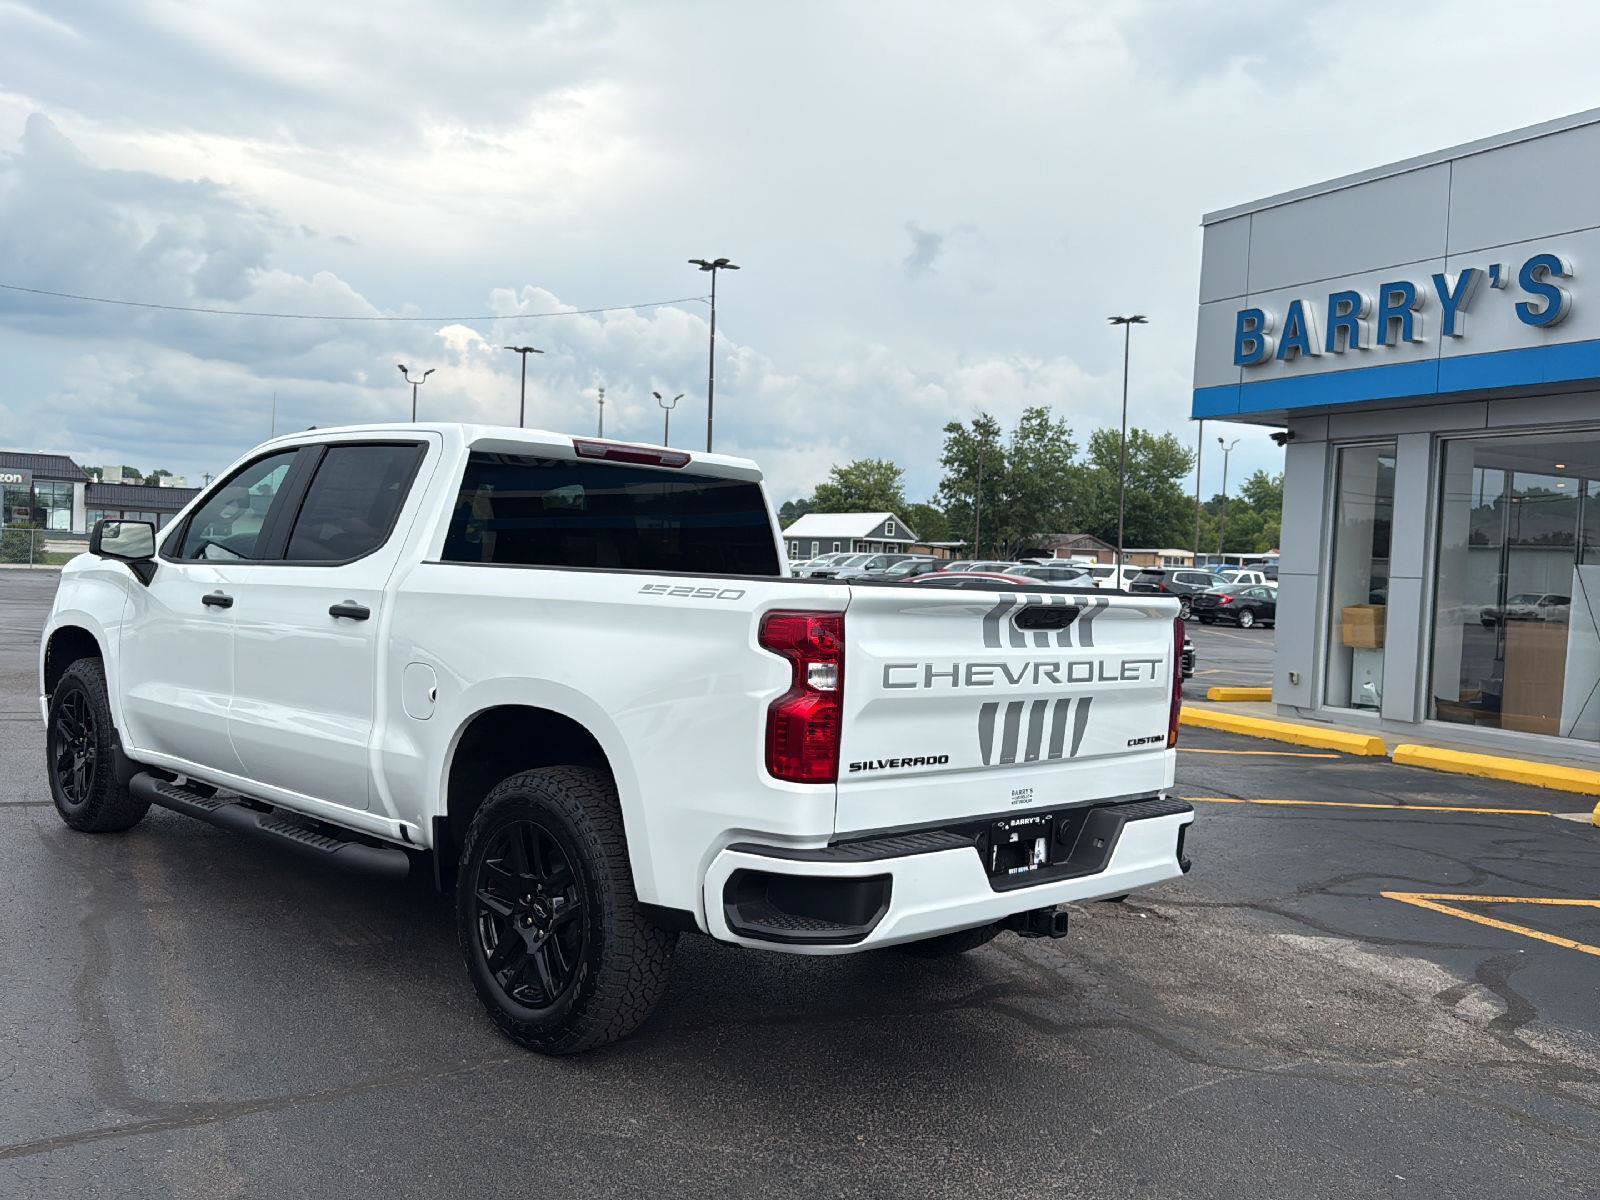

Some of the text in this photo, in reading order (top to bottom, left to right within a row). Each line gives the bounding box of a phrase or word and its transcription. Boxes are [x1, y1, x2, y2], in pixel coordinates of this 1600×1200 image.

[1233, 253, 1573, 367] BARRY'S
[882, 658, 1164, 689] CHEVROLET
[1127, 734, 1165, 747] CUSTOM
[848, 754, 949, 773] SILVERADO
[1010, 816, 1040, 826] BARRY'S
